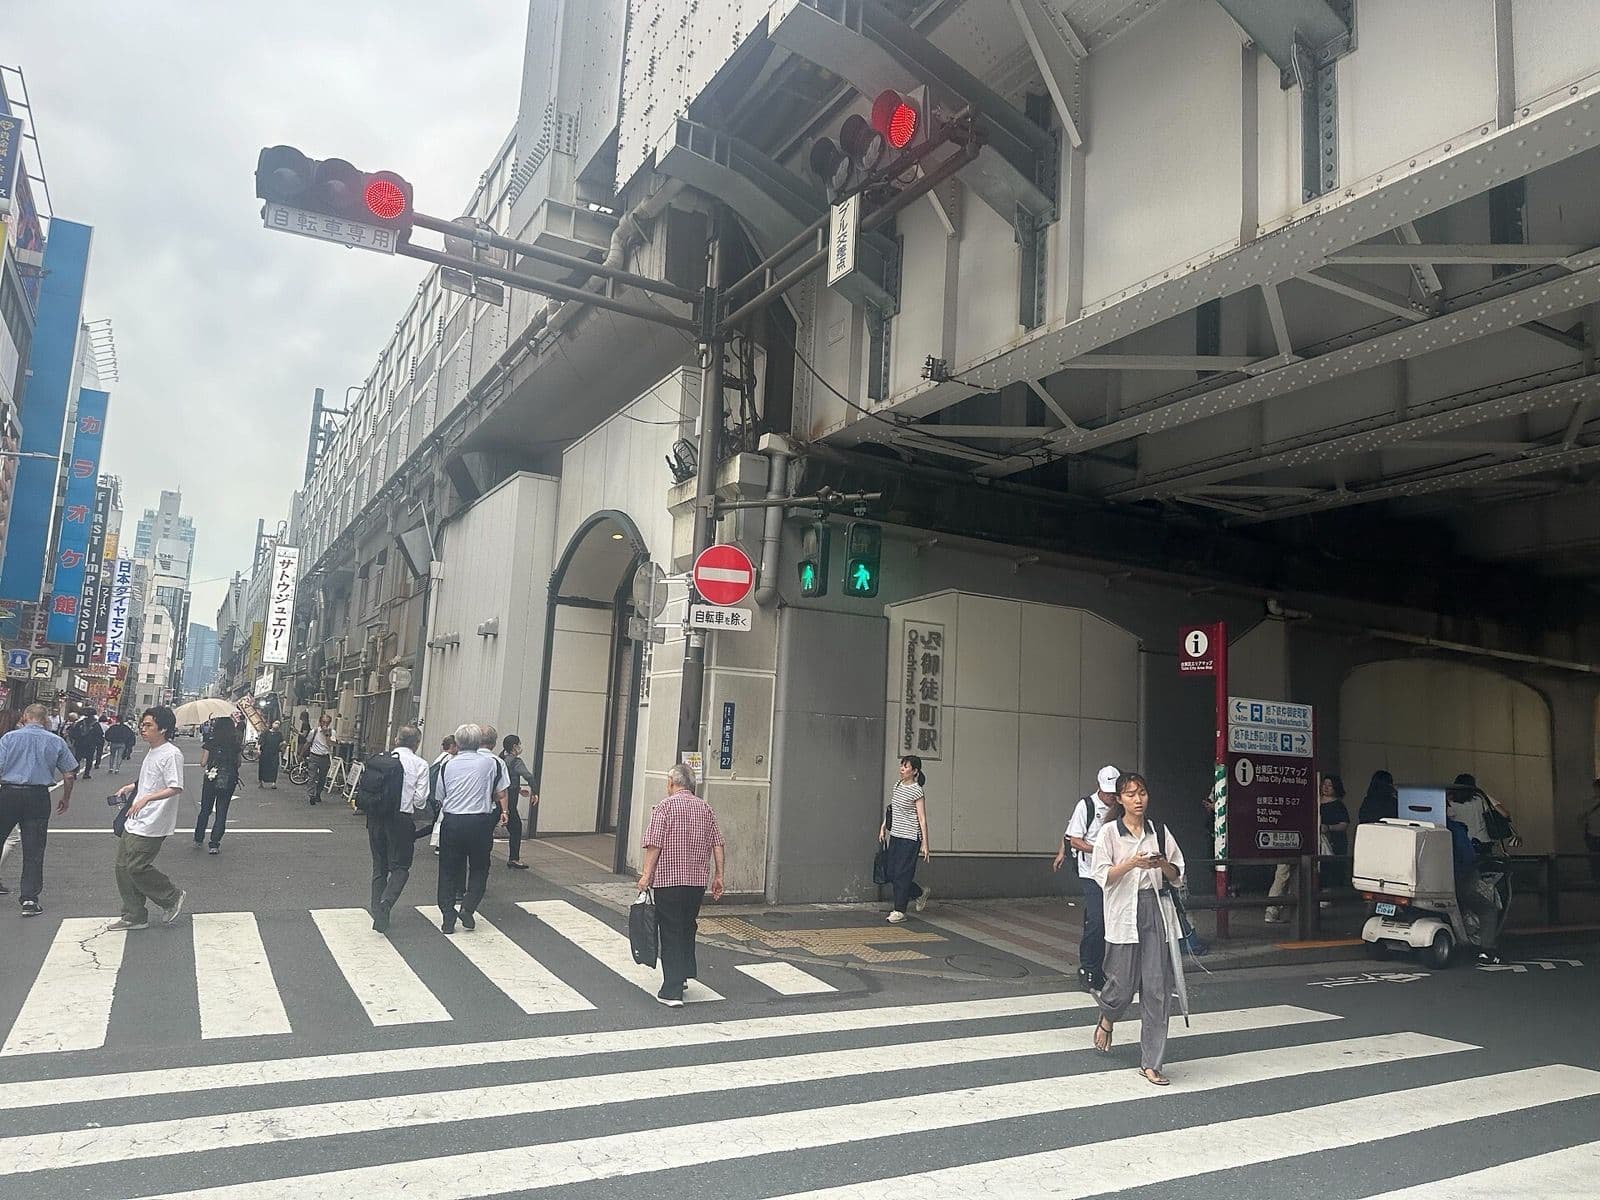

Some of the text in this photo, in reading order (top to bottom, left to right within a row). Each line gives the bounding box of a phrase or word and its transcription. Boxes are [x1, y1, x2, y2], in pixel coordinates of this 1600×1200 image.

[274, 207, 390, 249] 自転車専用
[54, 415, 101, 616] カラオケ館
[92, 491, 106, 546] FIRST
[272, 559, 294, 651] サトウジュエリー
[696, 610, 746, 626] 自転車を除く
[904, 629, 918, 750] Okachimachi Station
[722, 757, 731, 766] 27
[1255, 765, 1308, 776] 台東区エリアマップ
[1255, 775, 1308, 786] Taito City Area Map
[1268, 816, 1278, 824] City
